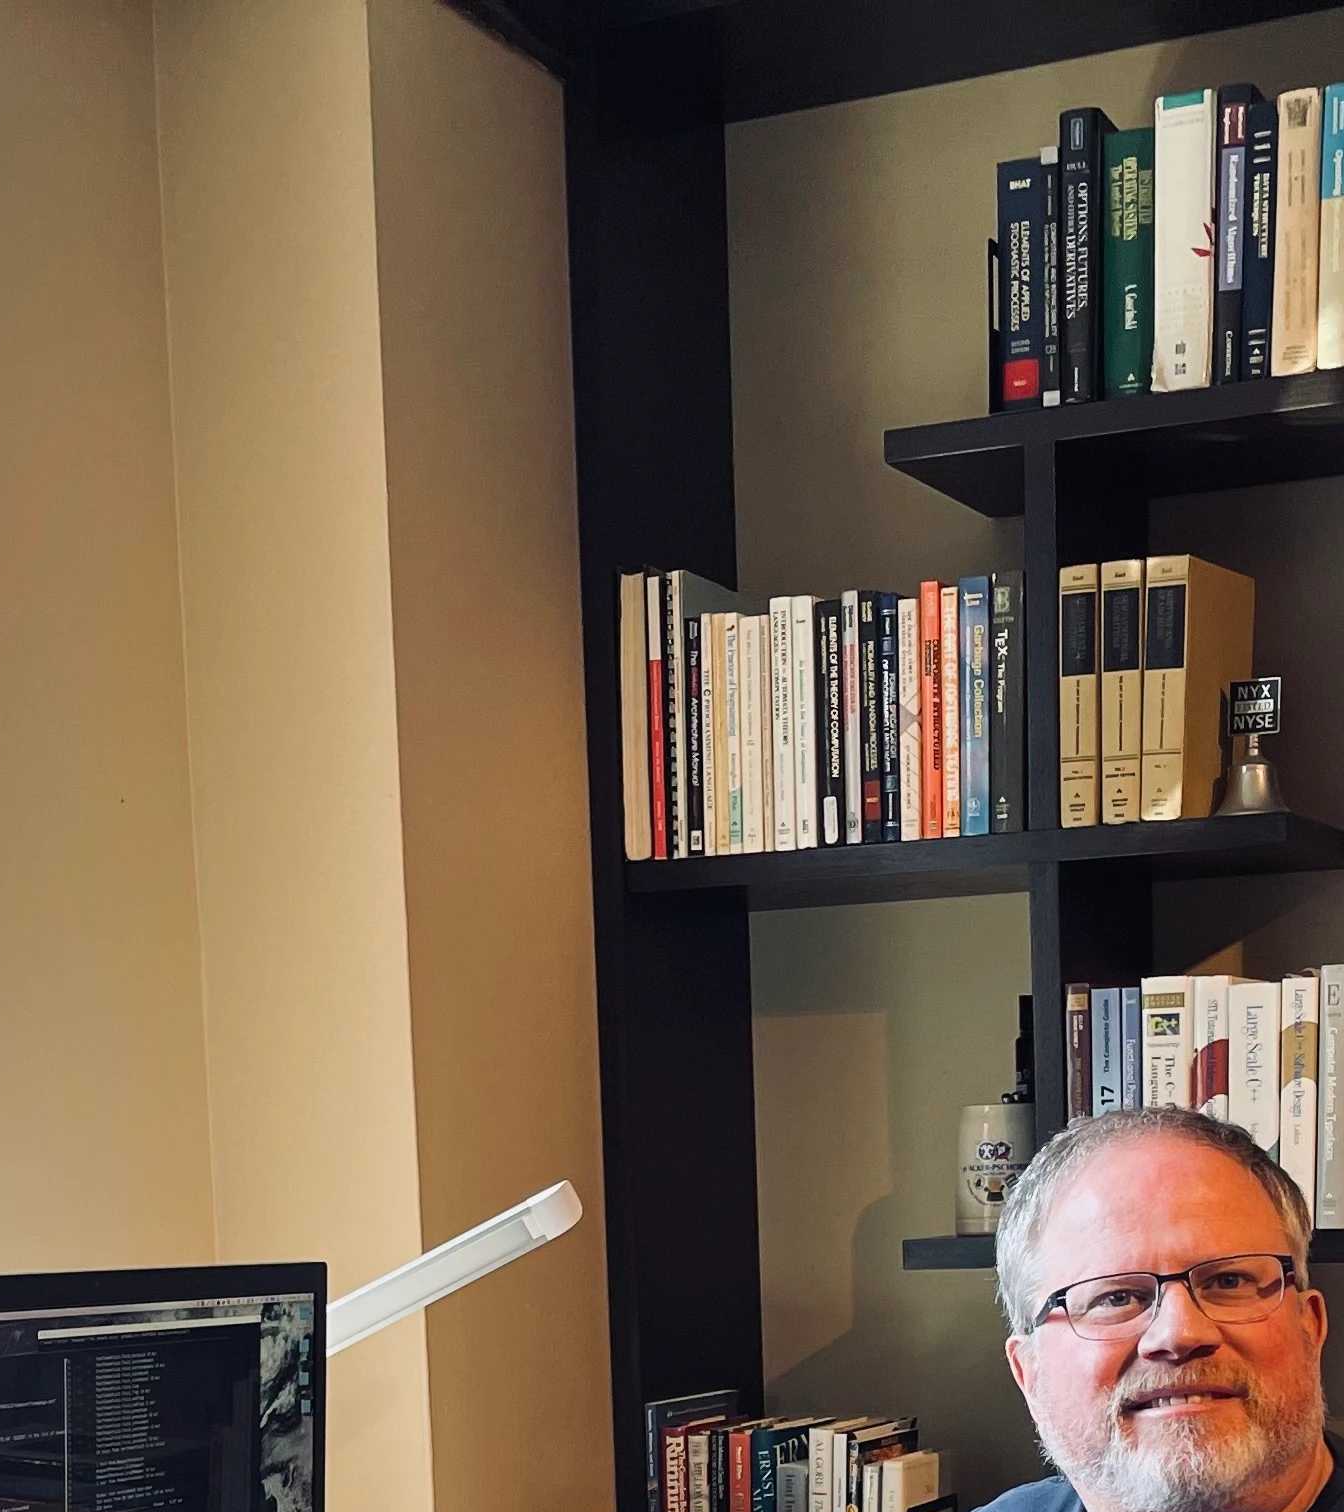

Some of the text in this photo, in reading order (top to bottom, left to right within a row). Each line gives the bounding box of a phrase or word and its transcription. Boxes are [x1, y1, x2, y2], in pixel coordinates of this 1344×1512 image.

[1021, 221, 1030, 321] ELEMENTS OF APPLIED
[1076, 183, 1088, 311] OPTIONS, FUTURES,
[1011, 223, 1019, 331] STOCHASTIC PROCESSES
[1066, 235, 1076, 319] DERIVATIVES
[828, 617, 839, 777] ELEMENTS OF THE THEORY OF COMPUTATION
[971, 625, 984, 737] Garbage Collection
[1238, 684, 1271, 700] NYX
[1234, 713, 1274, 729] NYSE
[1127, 1039, 1136, 1083] Functional
[1165, 1056, 1175, 1077] The
[1241, 1005, 1263, 1103] Large Scale C++
[1325, 1027, 1338, 1073] Computer
[1101, 1086, 1115, 1105] 17
[1150, 1056, 1161, 1107] Languag
[1325, 1077, 1337, 1113] Modern
[757, 1450, 774, 1499] ERNST
[815, 1439, 824, 1487] AL GORE
